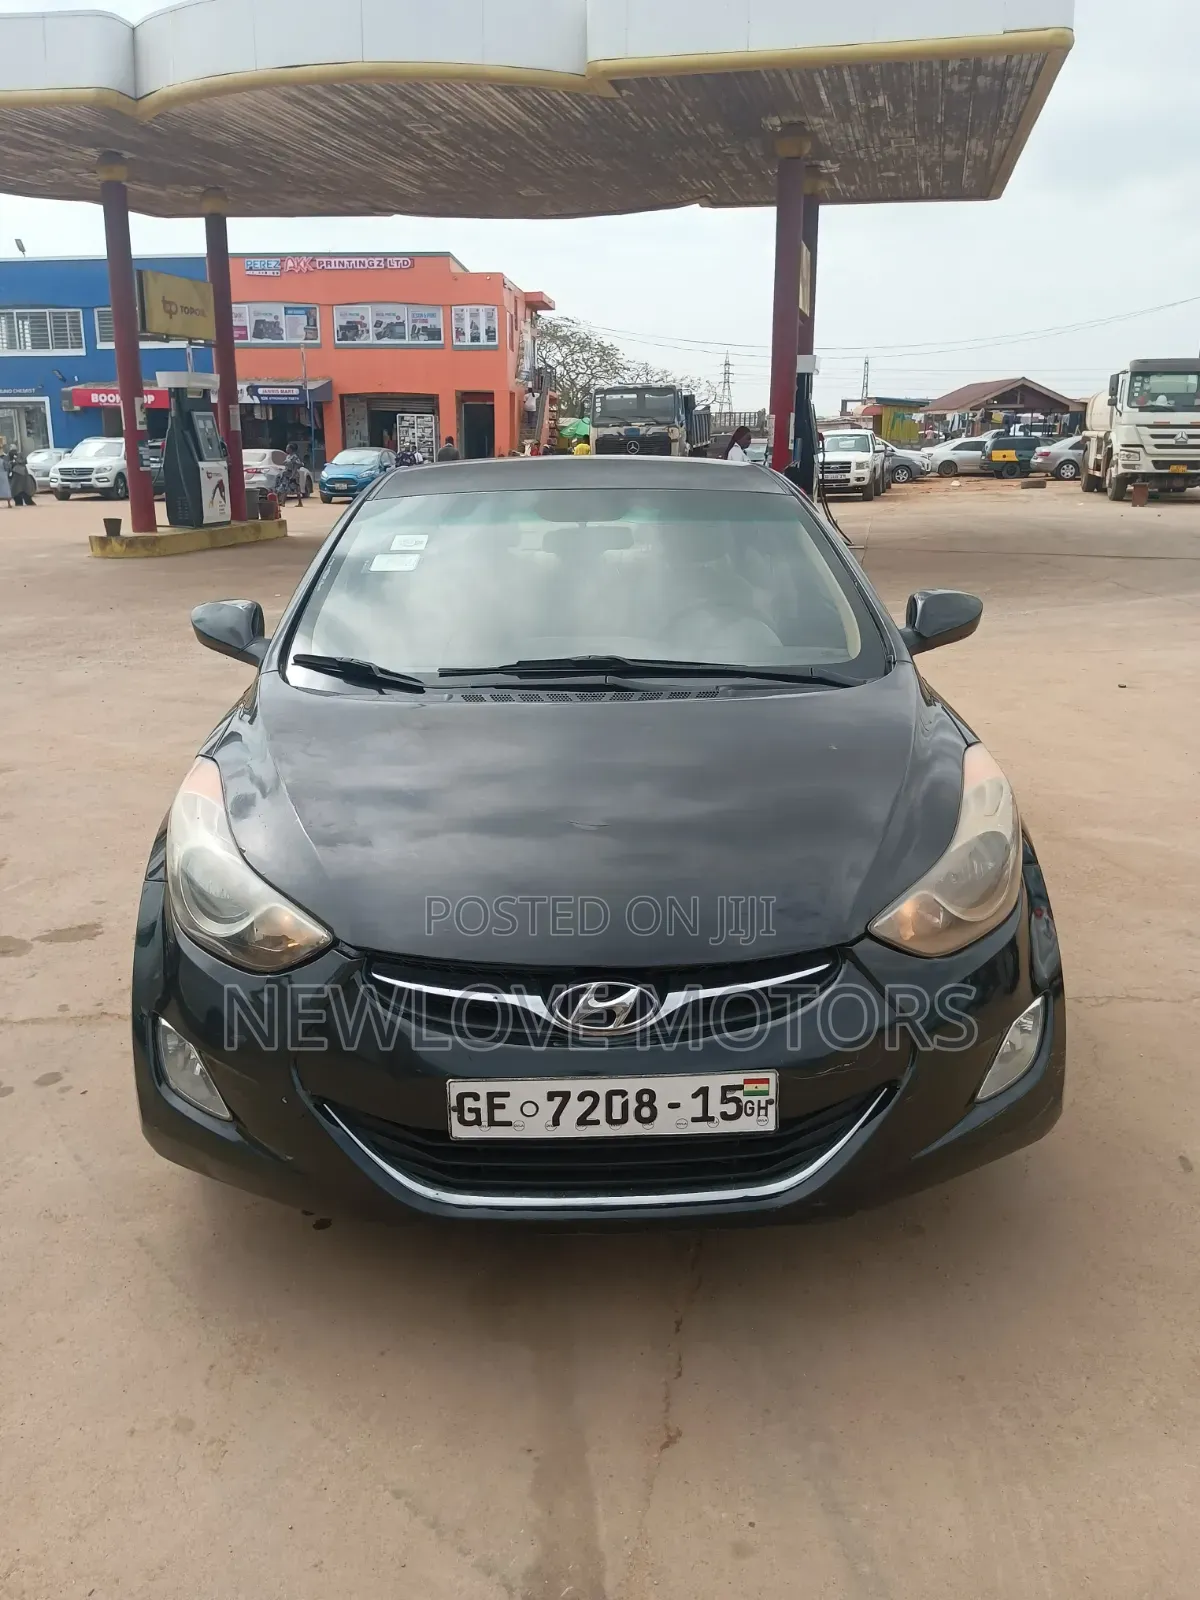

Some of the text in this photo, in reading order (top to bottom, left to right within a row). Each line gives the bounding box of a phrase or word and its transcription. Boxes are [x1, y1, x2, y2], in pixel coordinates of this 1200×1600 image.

[245, 260, 281, 269] PEREZ
[317, 260, 384, 268] PRINTINGZ
[388, 259, 411, 268] LTD
[456, 1091, 513, 1127] GE
[744, 1099, 769, 1117] GH
